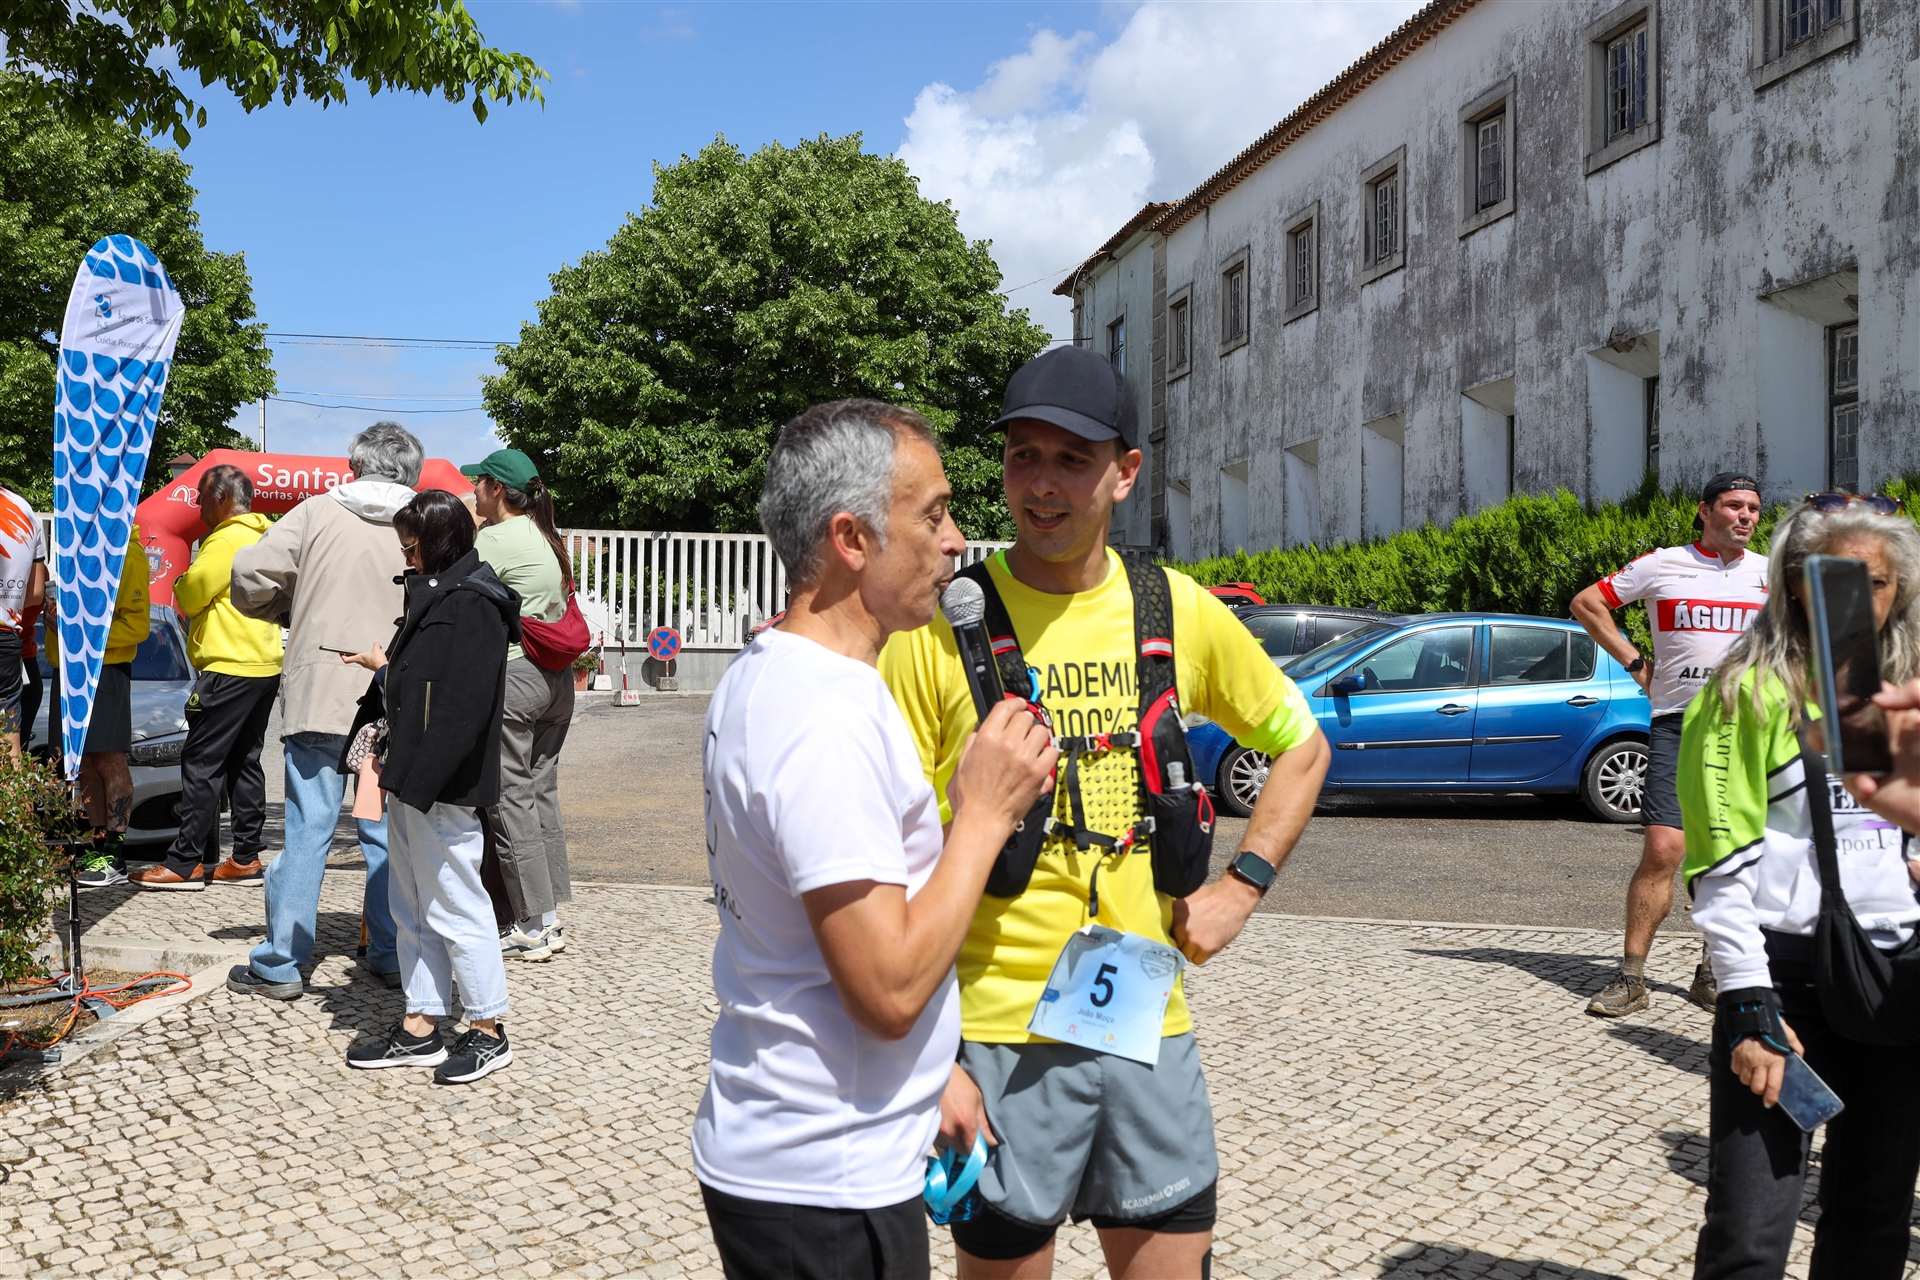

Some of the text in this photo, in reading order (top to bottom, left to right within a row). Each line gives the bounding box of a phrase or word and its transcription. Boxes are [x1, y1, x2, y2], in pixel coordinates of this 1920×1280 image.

[253, 488, 320, 500] Portas Ab
[1089, 962, 1118, 1008] 5
[1121, 1190, 1165, 1210] ACADEMIA
